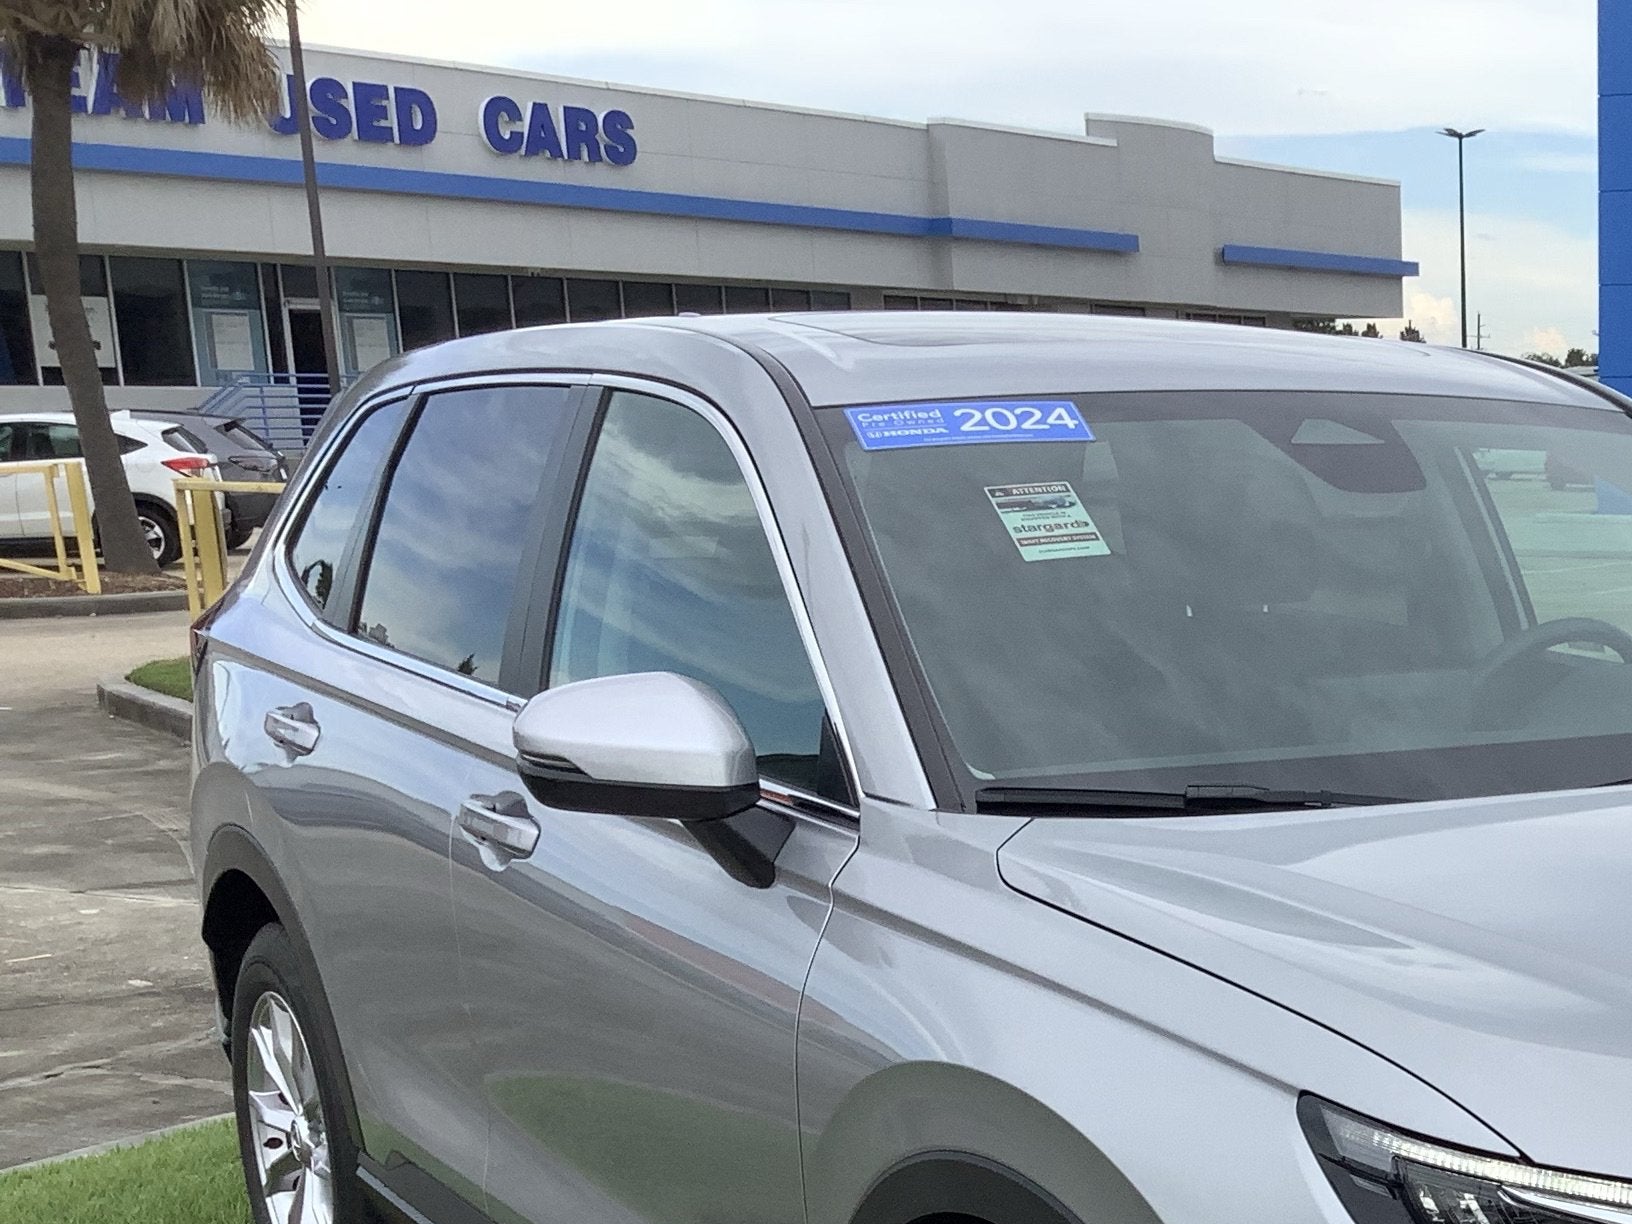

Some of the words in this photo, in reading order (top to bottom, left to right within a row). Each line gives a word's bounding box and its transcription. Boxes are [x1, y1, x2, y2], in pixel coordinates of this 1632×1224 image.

[0, 46, 206, 125] TAM
[264, 75, 438, 146] USED
[479, 95, 638, 166] CARS
[858, 408, 942, 422] Certified
[893, 418, 945, 426] Owned
[953, 407, 1079, 432] 2024
[884, 427, 949, 437] HONDA
[1012, 485, 1067, 495] ATTENTION
[1013, 519, 1083, 534] stargard
